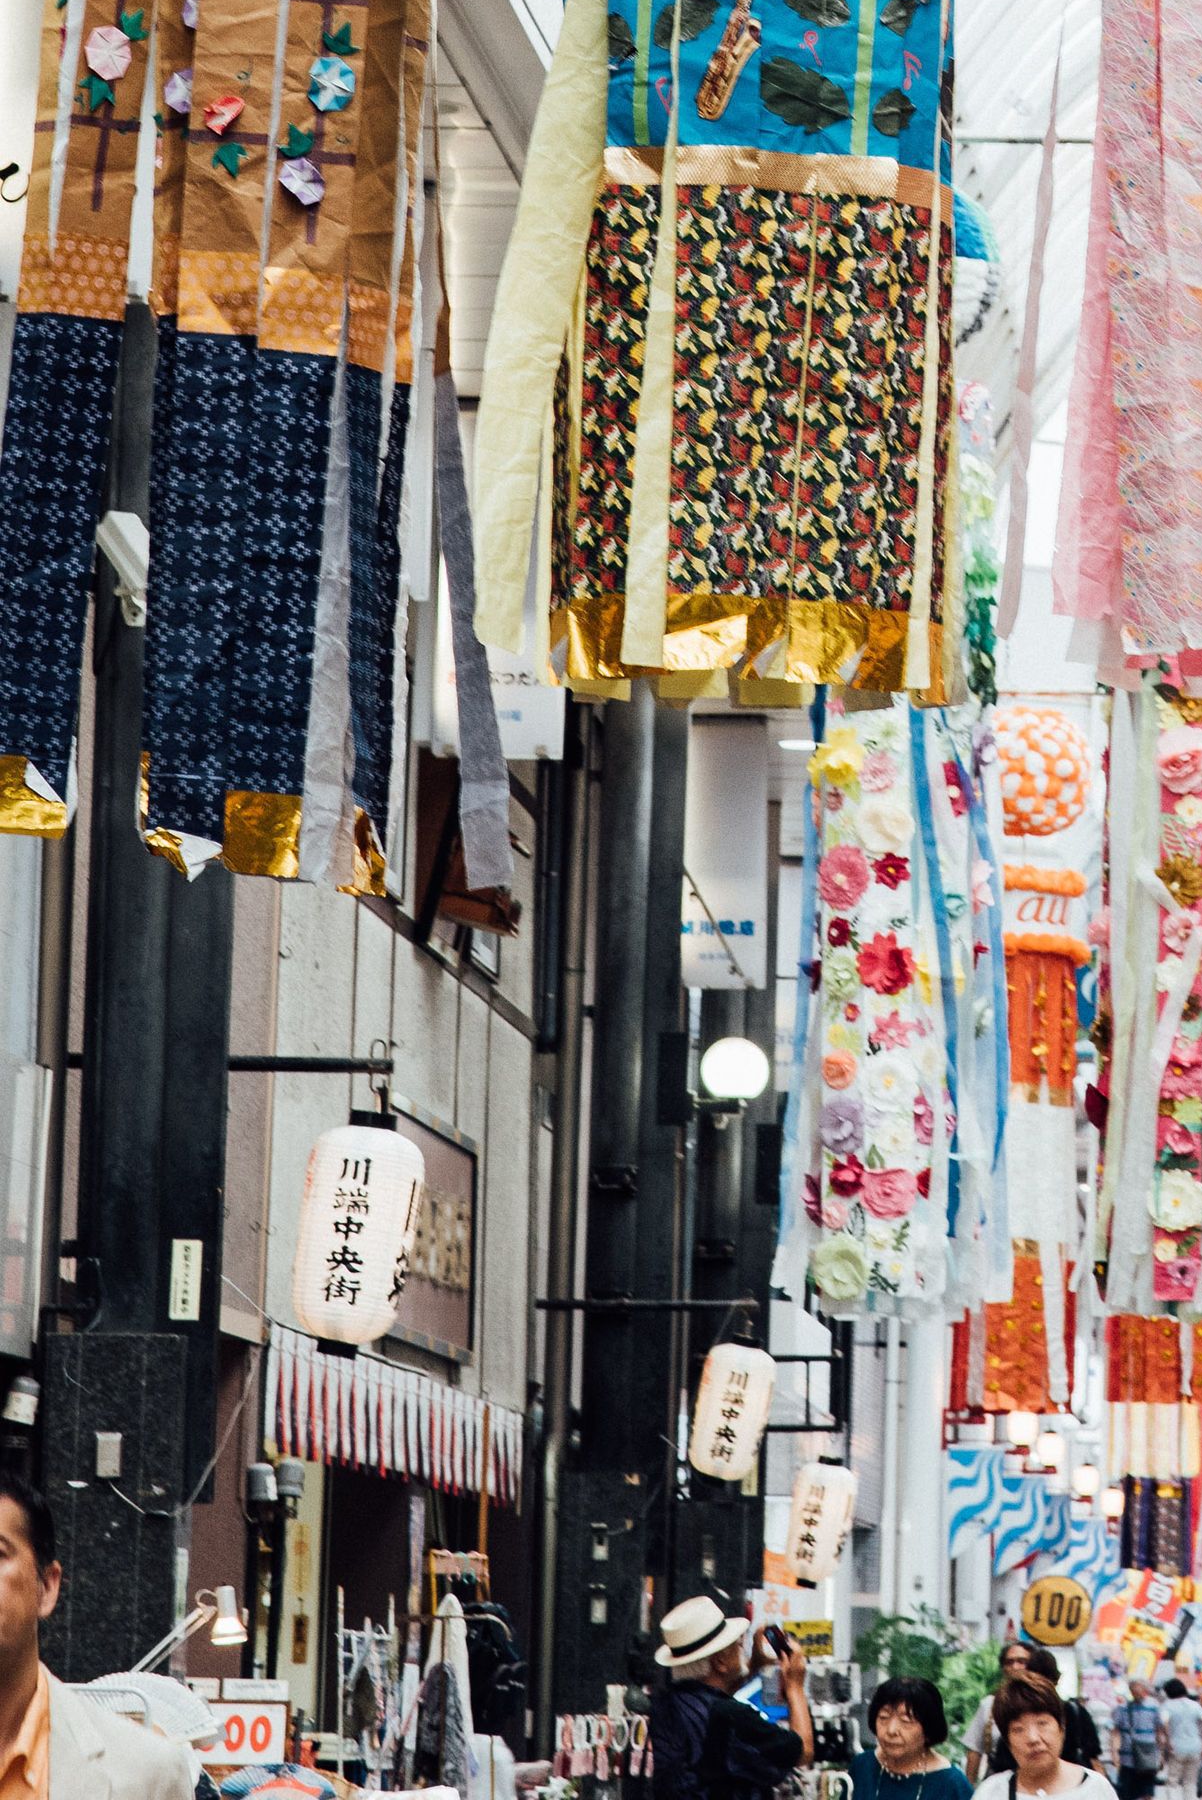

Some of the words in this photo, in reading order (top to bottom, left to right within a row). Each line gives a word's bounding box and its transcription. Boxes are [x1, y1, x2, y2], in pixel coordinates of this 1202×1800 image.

[1016, 896, 1069, 925] au
[323, 1157, 372, 1306] 川端中央街
[1033, 1591, 1083, 1631] 100
[193, 1714, 272, 1753] 00
